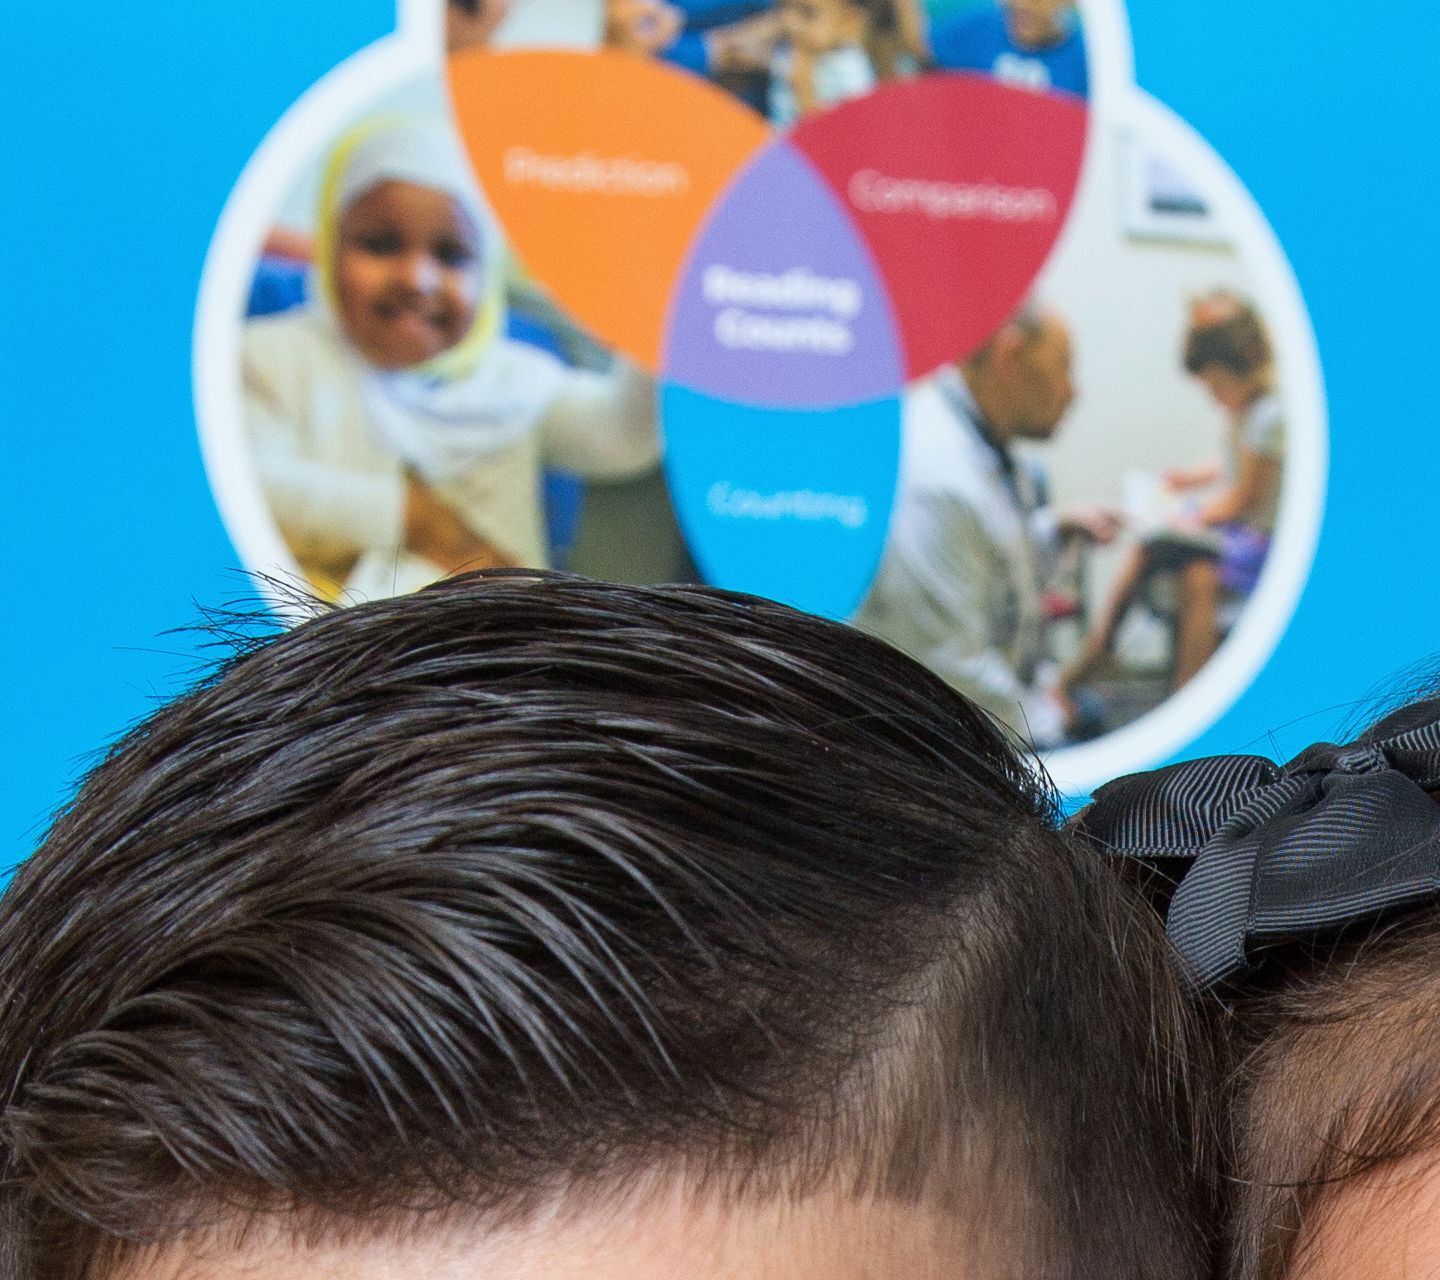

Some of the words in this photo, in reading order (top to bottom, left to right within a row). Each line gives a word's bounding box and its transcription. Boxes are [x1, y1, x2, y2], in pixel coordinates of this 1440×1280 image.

[503, 147, 691, 196] Prediction
[848, 169, 1056, 223] Comparison
[705, 265, 861, 318] Reading
[715, 309, 851, 354] Counts
[709, 482, 866, 528] Counting
